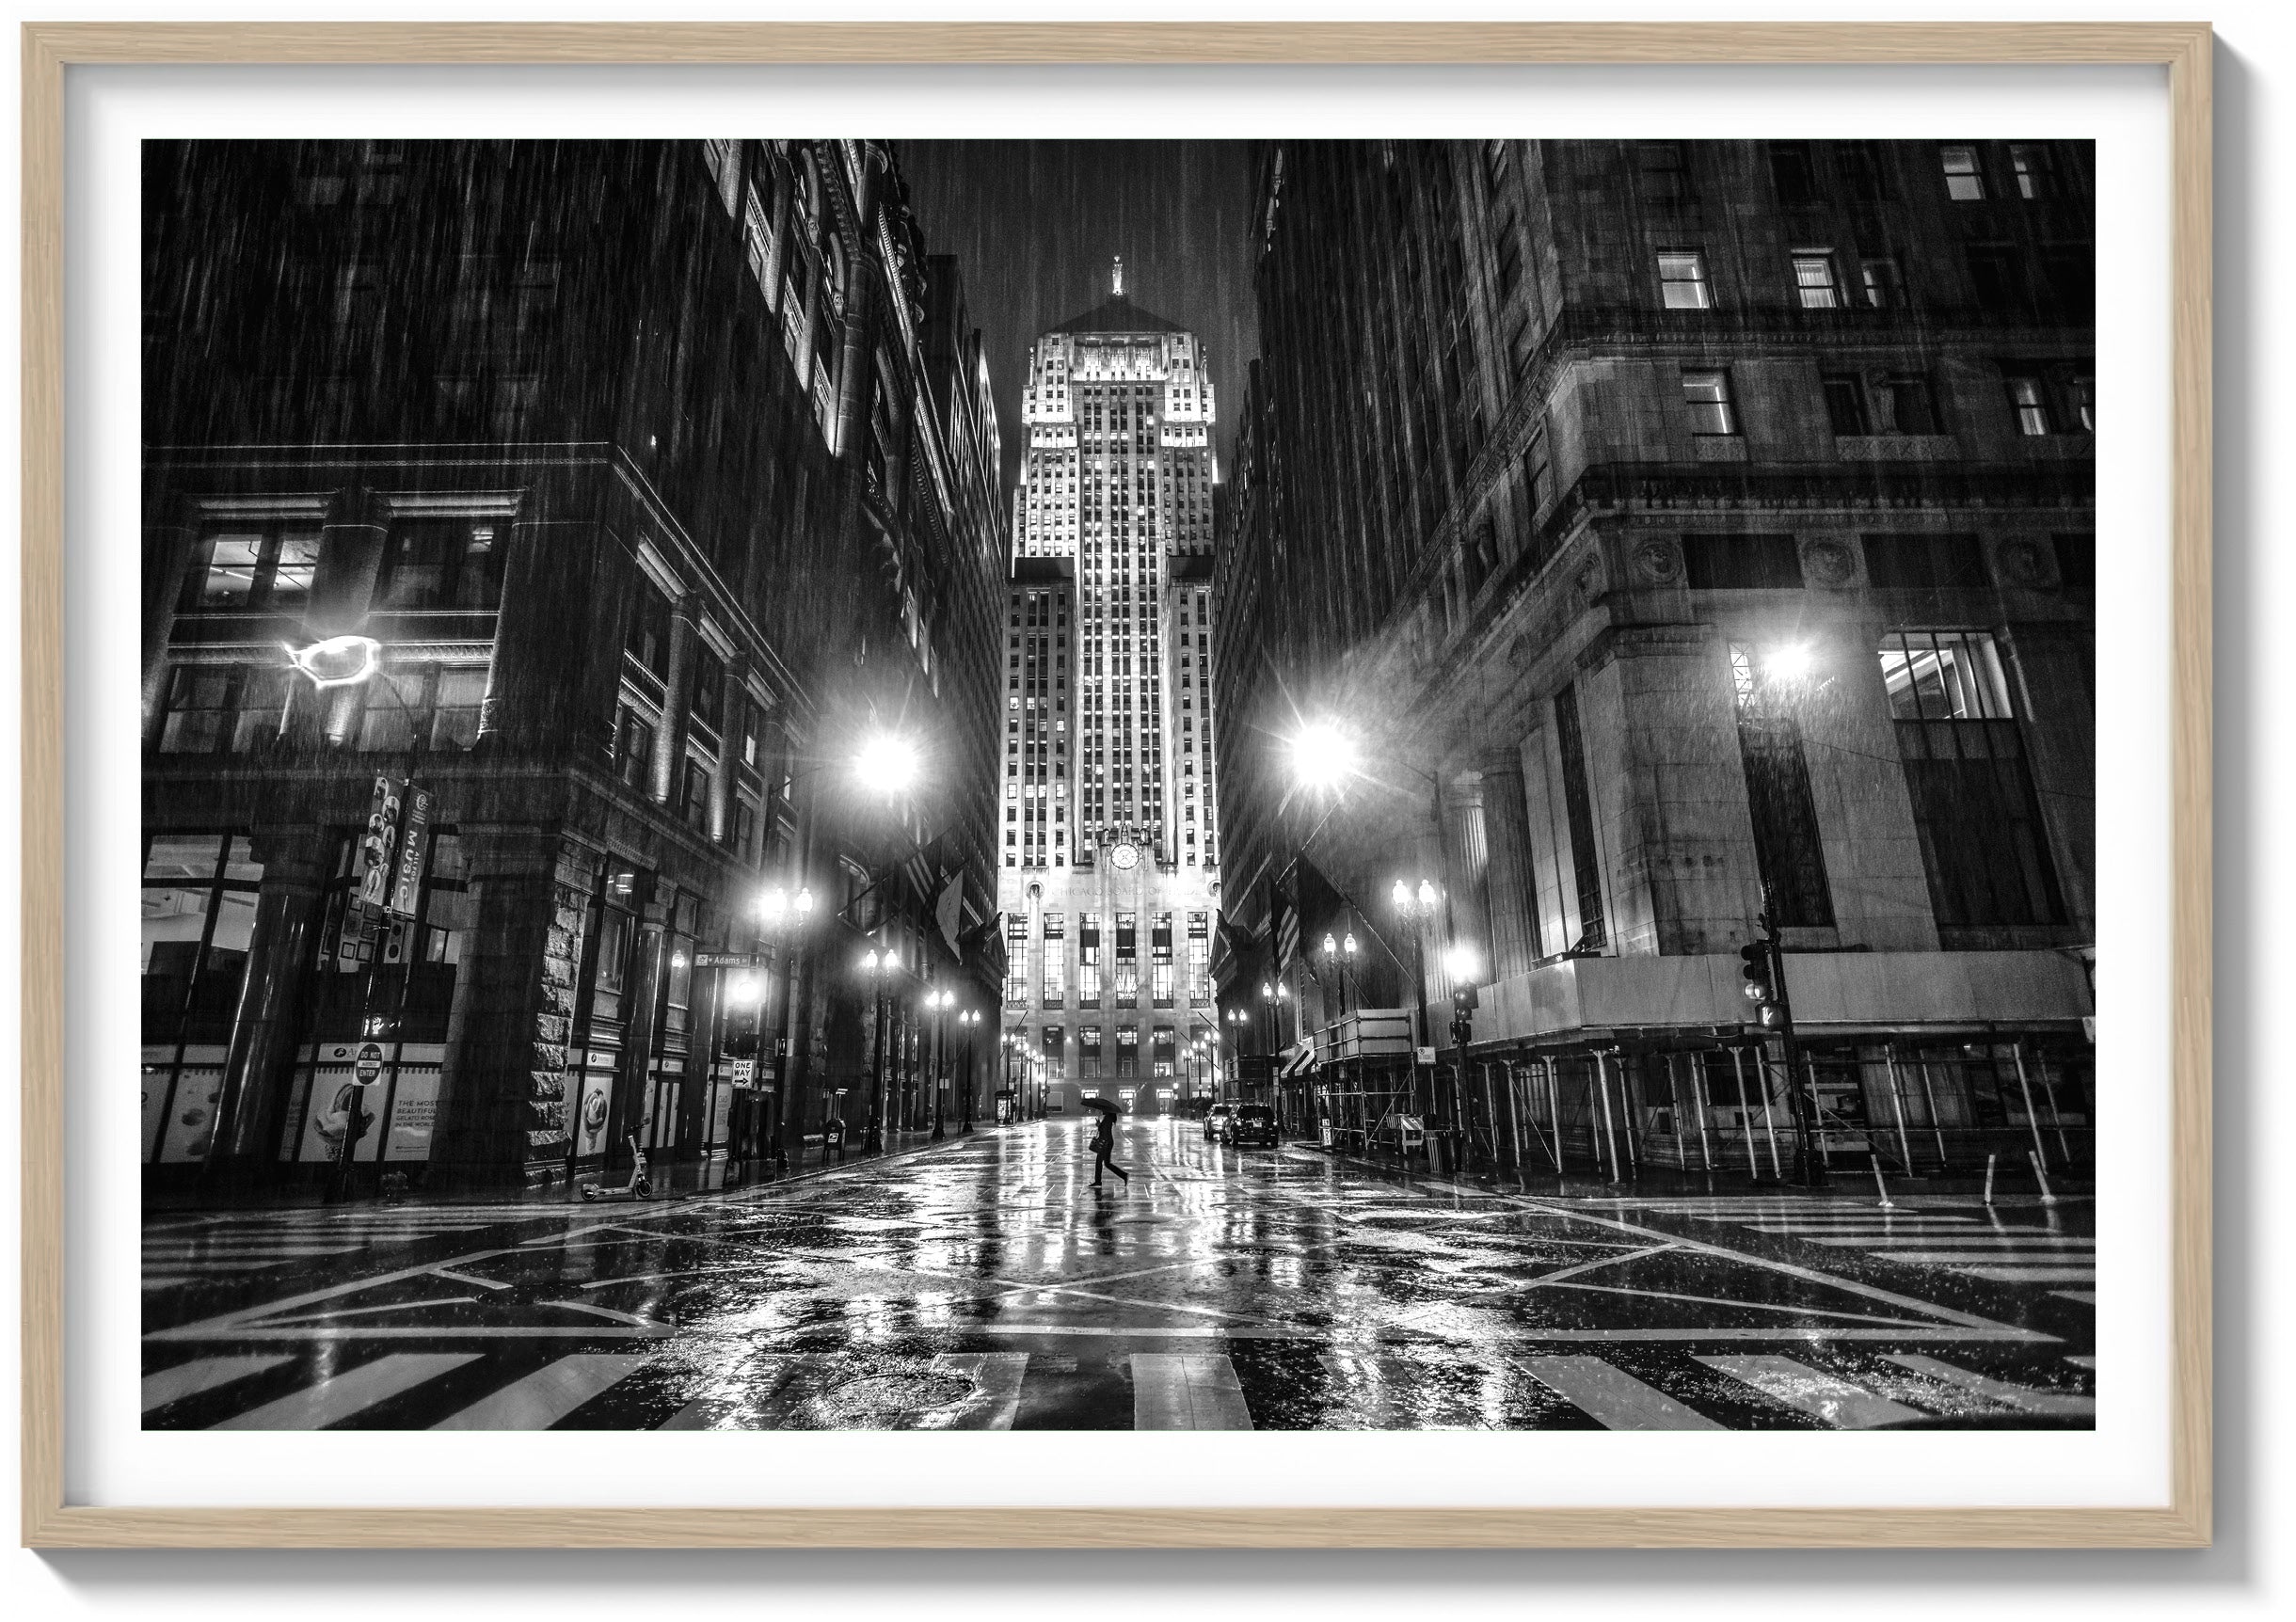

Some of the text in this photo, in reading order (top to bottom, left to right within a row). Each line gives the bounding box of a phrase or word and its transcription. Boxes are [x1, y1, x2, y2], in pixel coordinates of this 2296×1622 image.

[399, 830, 418, 898] MUSIC
[1052, 887, 1103, 896] CHICAGO
[713, 956, 741, 964] Adams
[370, 1051, 380, 1059] NOT
[359, 1069, 375, 1077] ENTER
